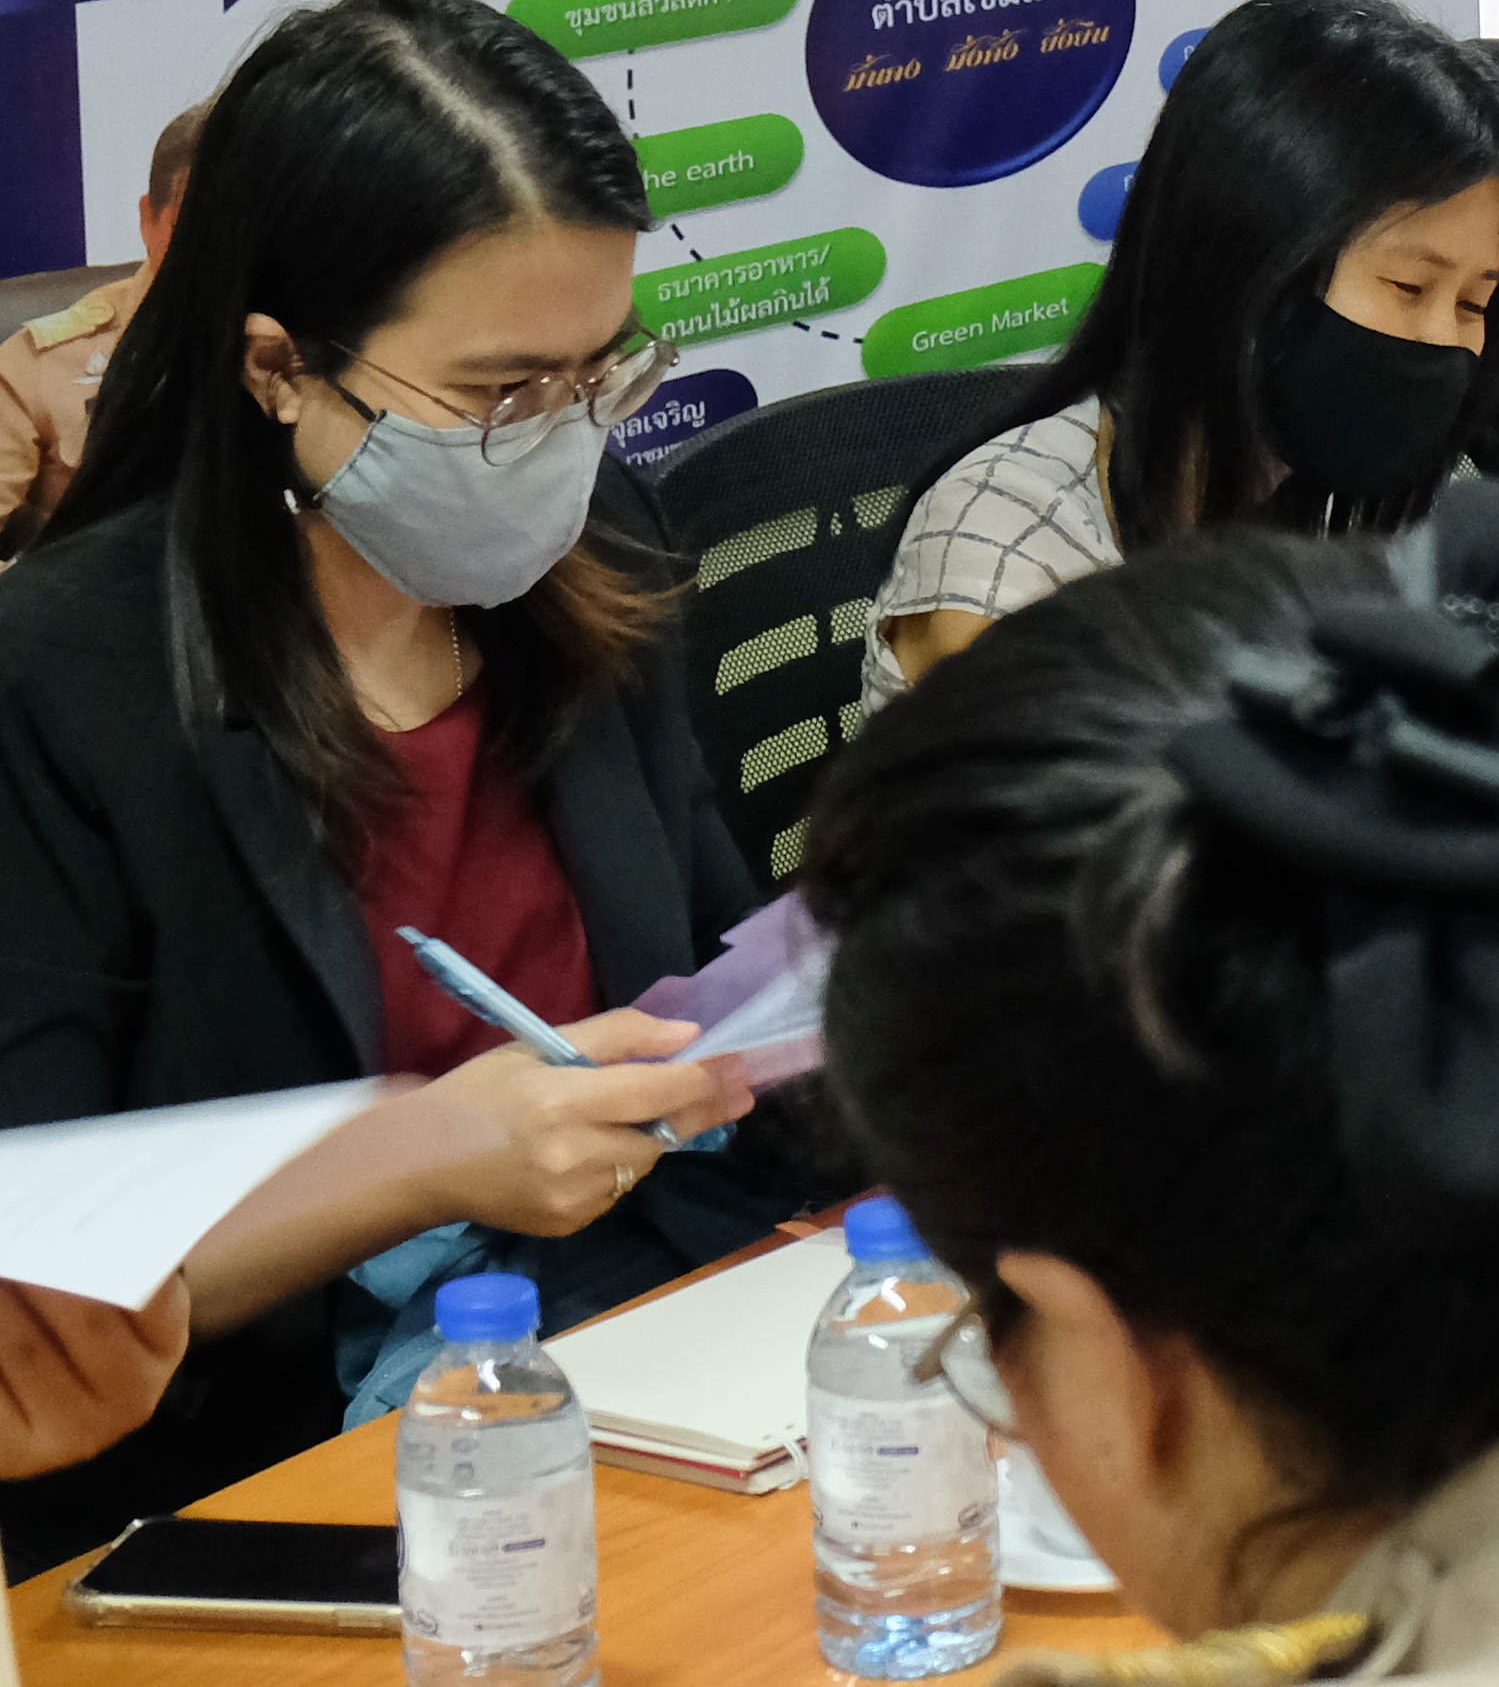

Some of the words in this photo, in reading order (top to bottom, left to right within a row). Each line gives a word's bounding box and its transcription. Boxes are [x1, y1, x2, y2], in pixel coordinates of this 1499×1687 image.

[643, 169, 675, 190] he
[686, 151, 754, 183] earth
[657, 244, 831, 302] ธนาคารอาหาร/
[912, 319, 984, 354] Green
[990, 298, 1070, 333] Market
